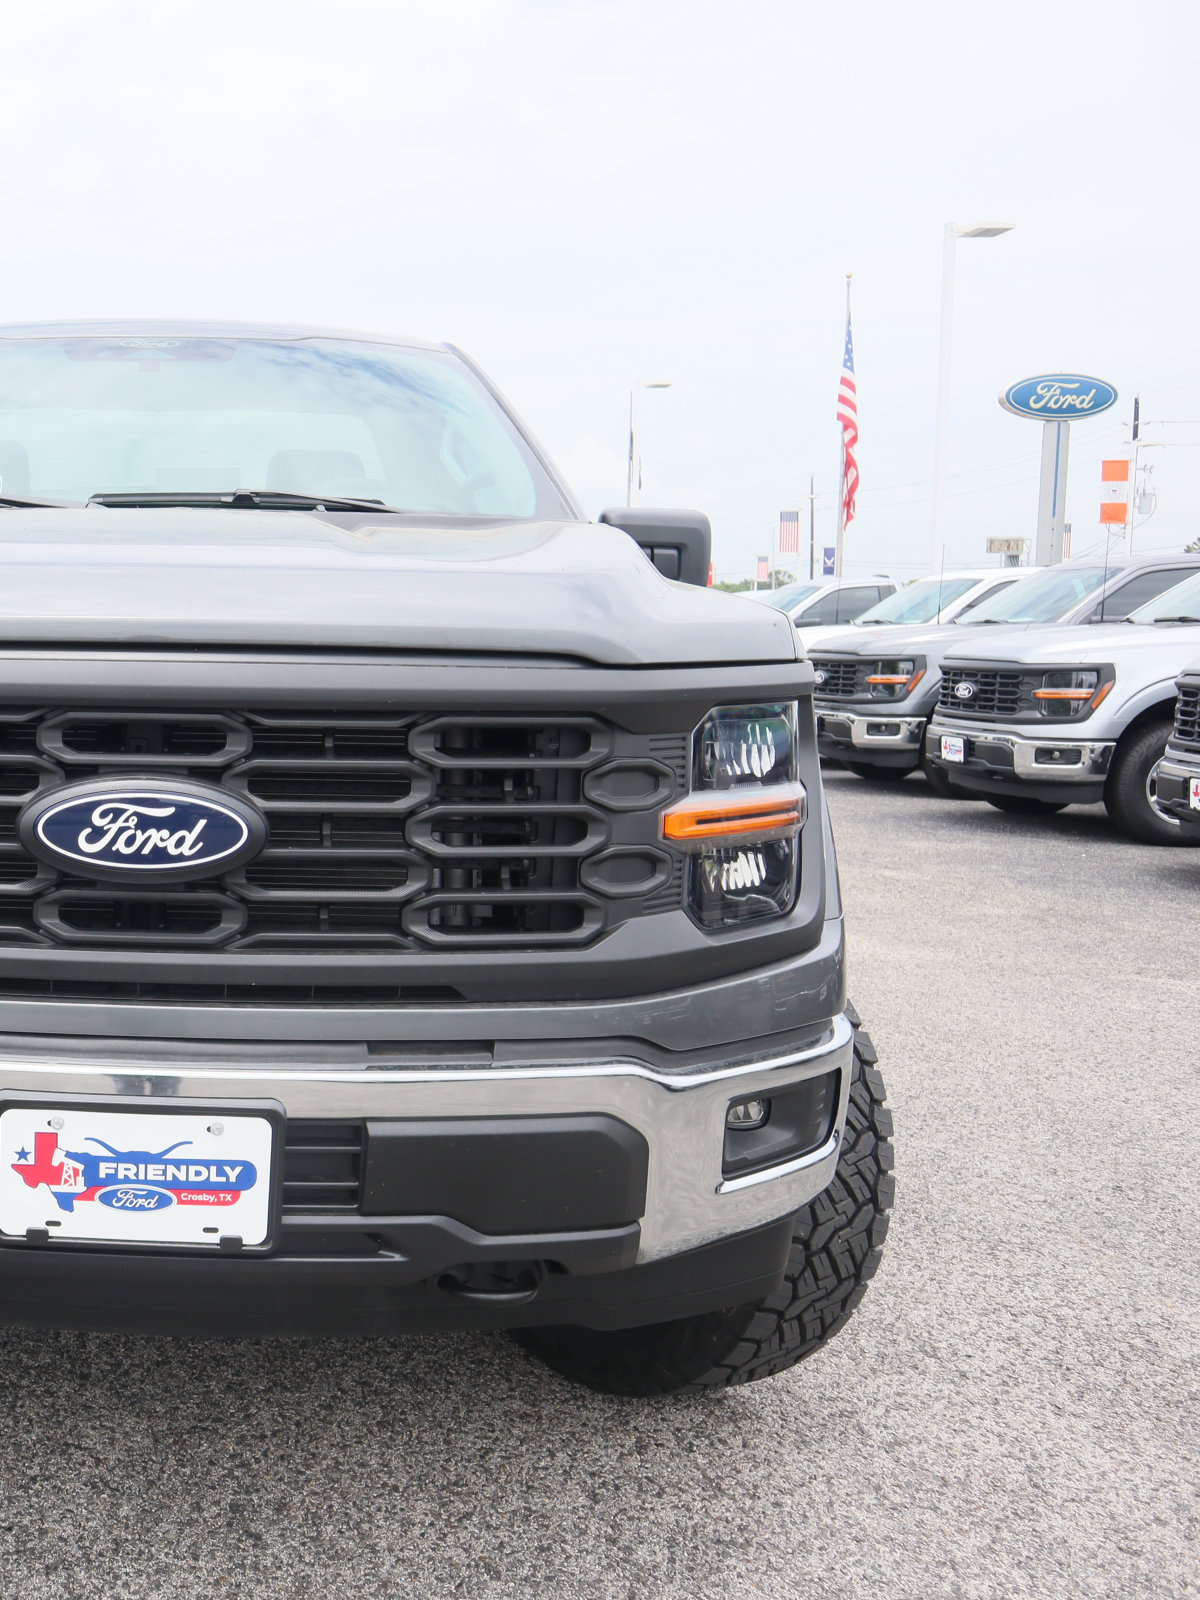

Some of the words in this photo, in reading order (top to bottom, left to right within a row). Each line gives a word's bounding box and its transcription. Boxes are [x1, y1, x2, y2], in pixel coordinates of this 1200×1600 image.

[1029, 381, 1097, 409] Ford
[77, 802, 208, 857] Ford
[99, 1162, 243, 1183] FRIENDLY
[112, 1188, 159, 1208] Ford
[181, 1192, 217, 1203] Crosby,
[219, 1193, 233, 1202] TX
